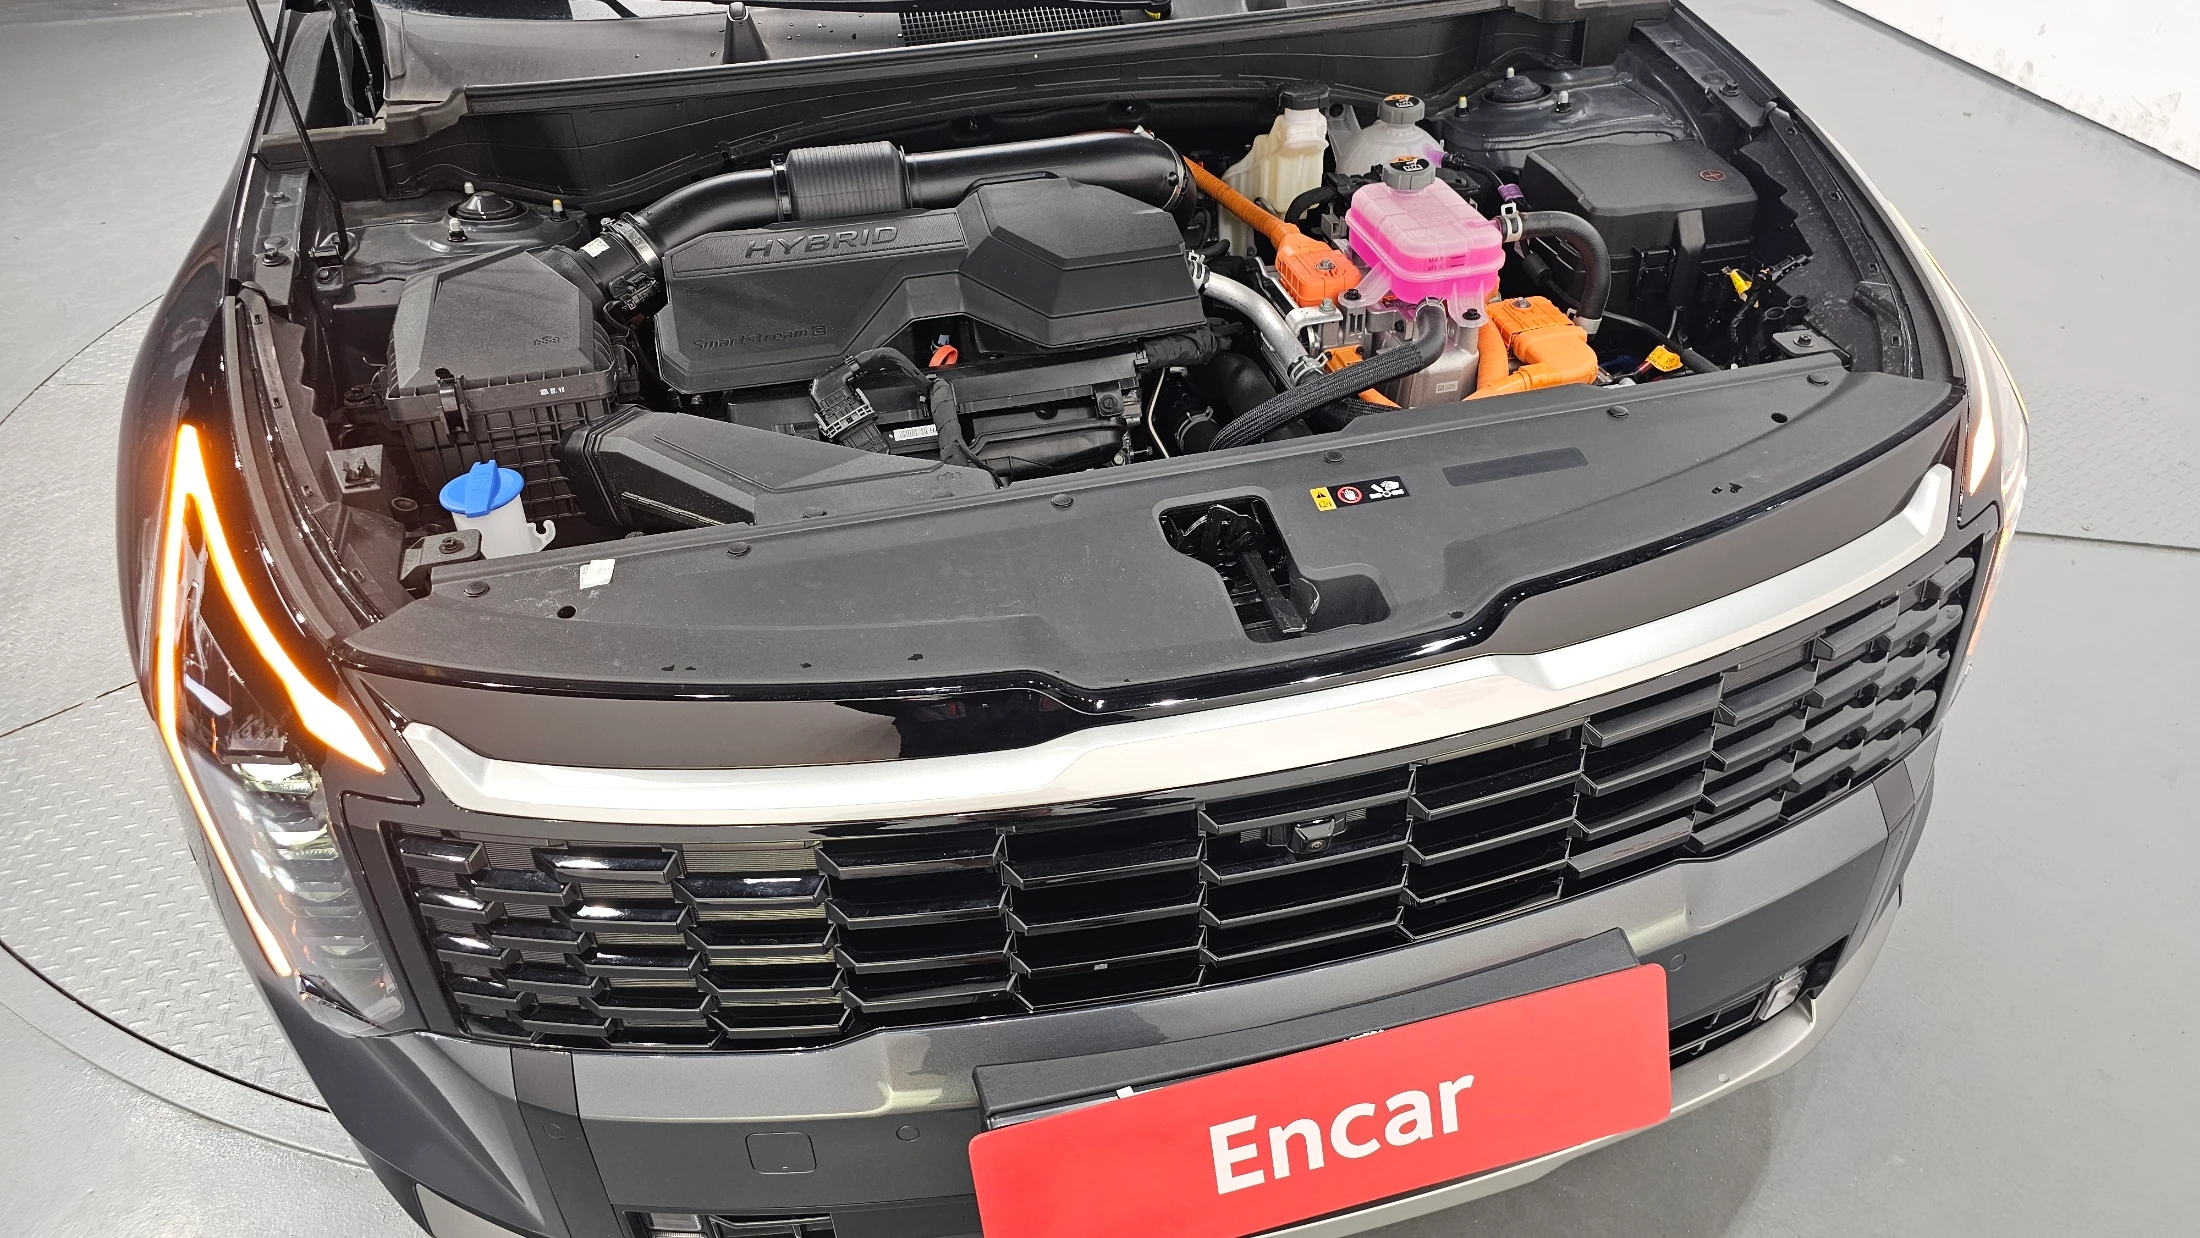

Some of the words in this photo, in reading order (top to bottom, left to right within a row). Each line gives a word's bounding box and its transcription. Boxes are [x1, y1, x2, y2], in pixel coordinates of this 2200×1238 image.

[745, 226, 898, 258] HYBRID
[1427, 264, 1444, 272] MIN
[1428, 255, 1444, 263] MAX
[692, 328, 809, 351] Smartstream
[1209, 1074, 1475, 1195] Encar
